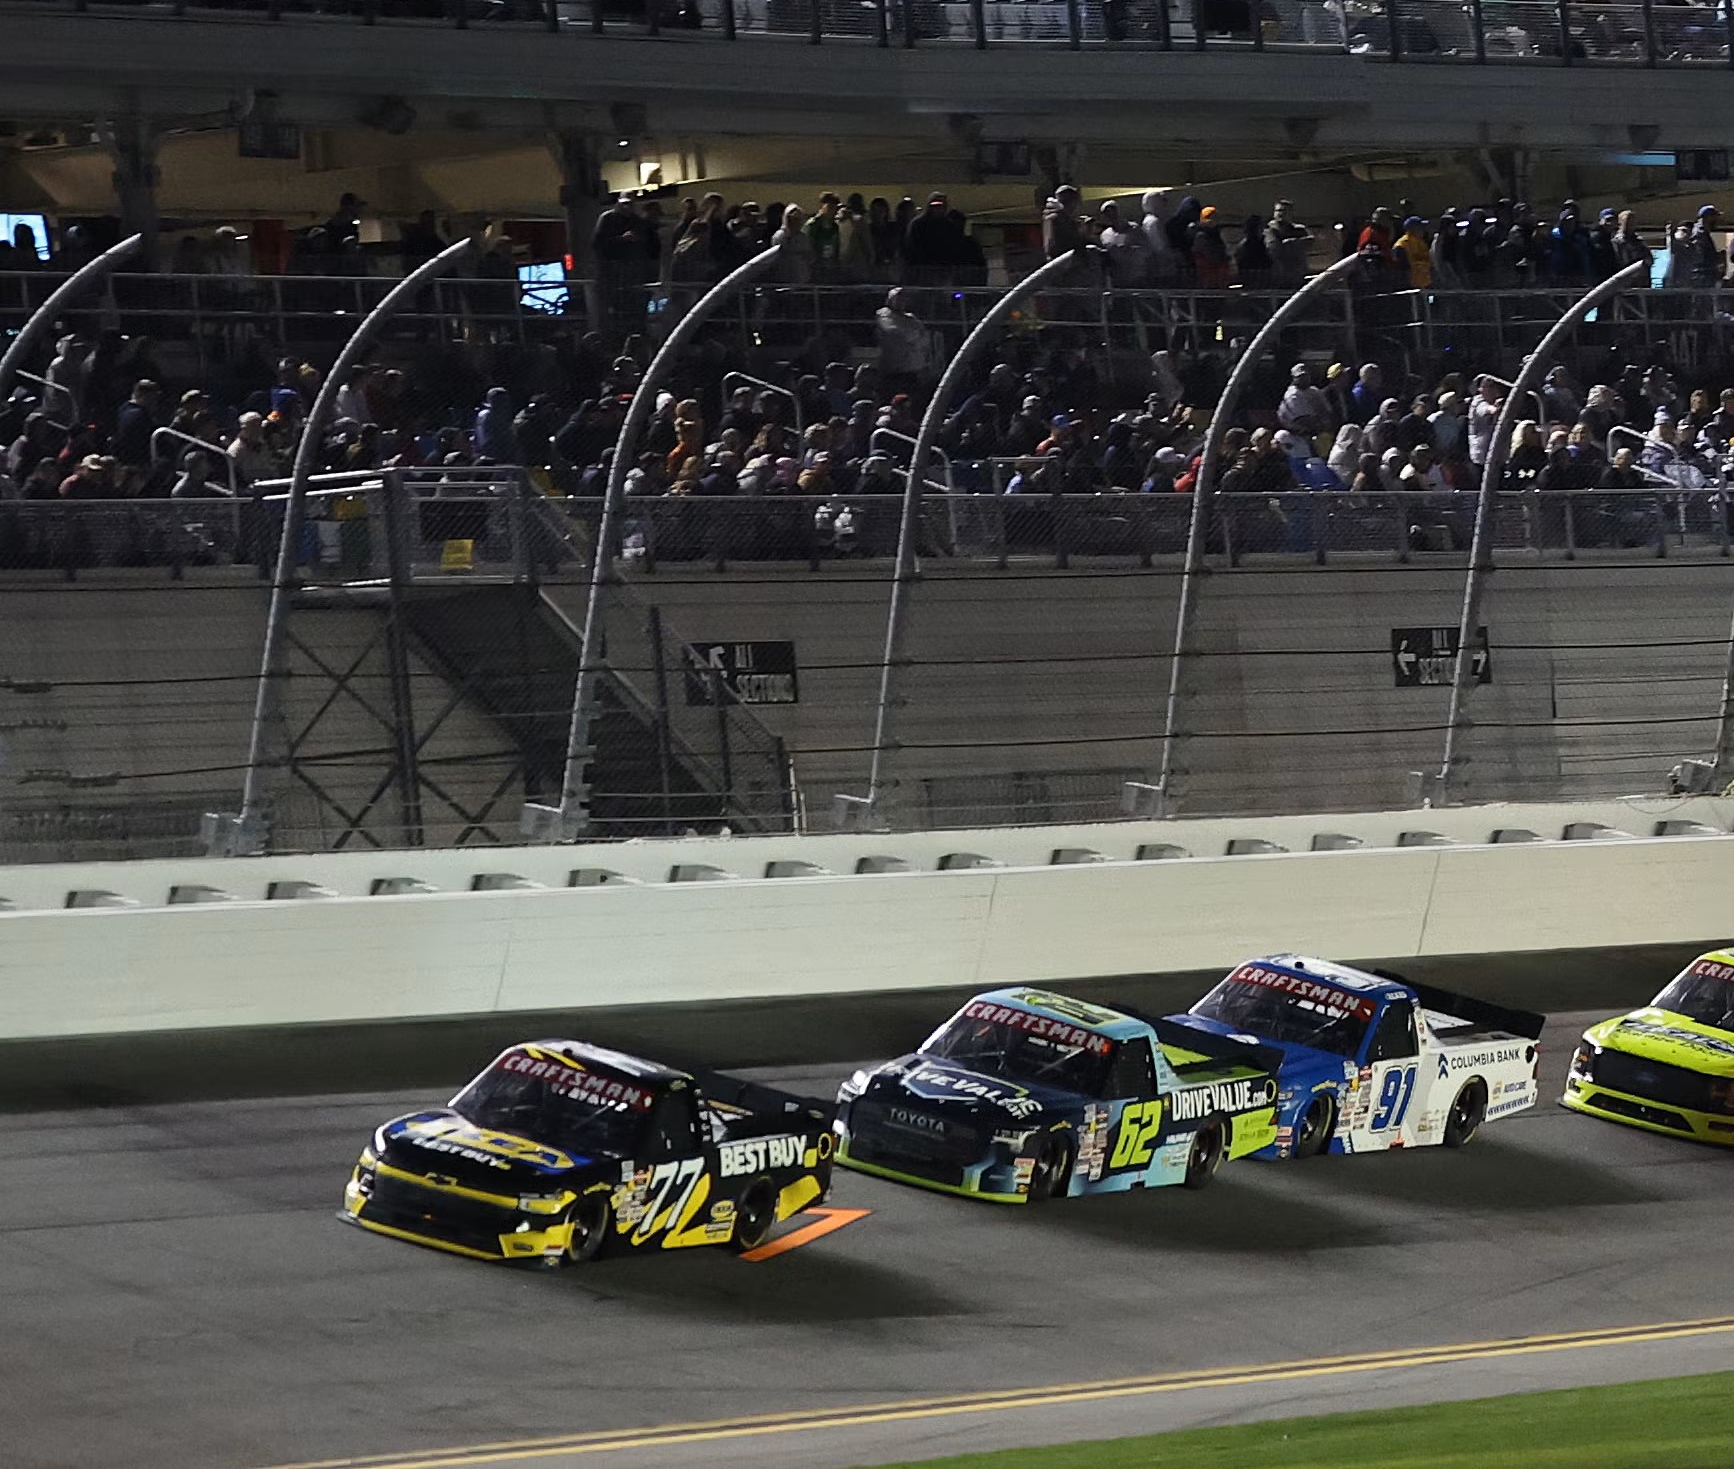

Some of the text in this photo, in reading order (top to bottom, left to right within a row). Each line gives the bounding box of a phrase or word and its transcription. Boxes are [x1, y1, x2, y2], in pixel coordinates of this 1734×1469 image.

[1239, 968, 1359, 1011] CRAFTSMAN
[966, 1003, 1105, 1051] CRAFTSMAN
[503, 1055, 641, 1106] CRAFTSMAN
[1451, 1047, 1520, 1069] COLUMBIA BANK
[890, 1107, 946, 1132] TOYOTA
[1172, 1081, 1267, 1122] DRIVEVALUE.com
[1369, 1065, 1419, 1133] 91
[720, 1134, 808, 1178] BEST BUY
[1109, 1099, 1163, 1169] 62
[640, 1156, 705, 1235] 77
